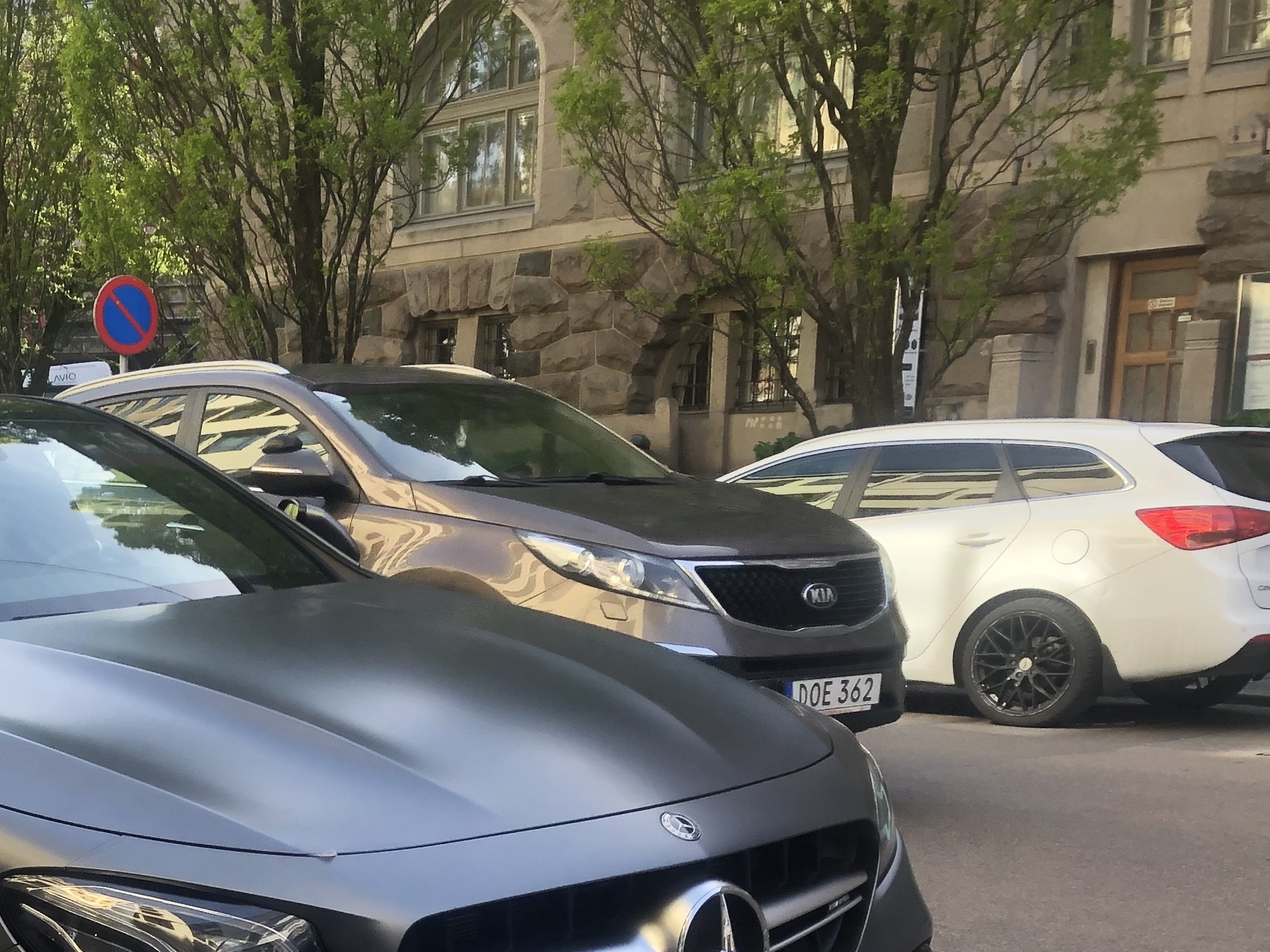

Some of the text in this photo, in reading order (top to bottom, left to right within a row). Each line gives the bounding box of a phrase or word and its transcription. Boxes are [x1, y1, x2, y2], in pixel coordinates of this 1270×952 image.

[811, 587, 834, 603] KIA
[799, 677, 874, 707] DOE 362
